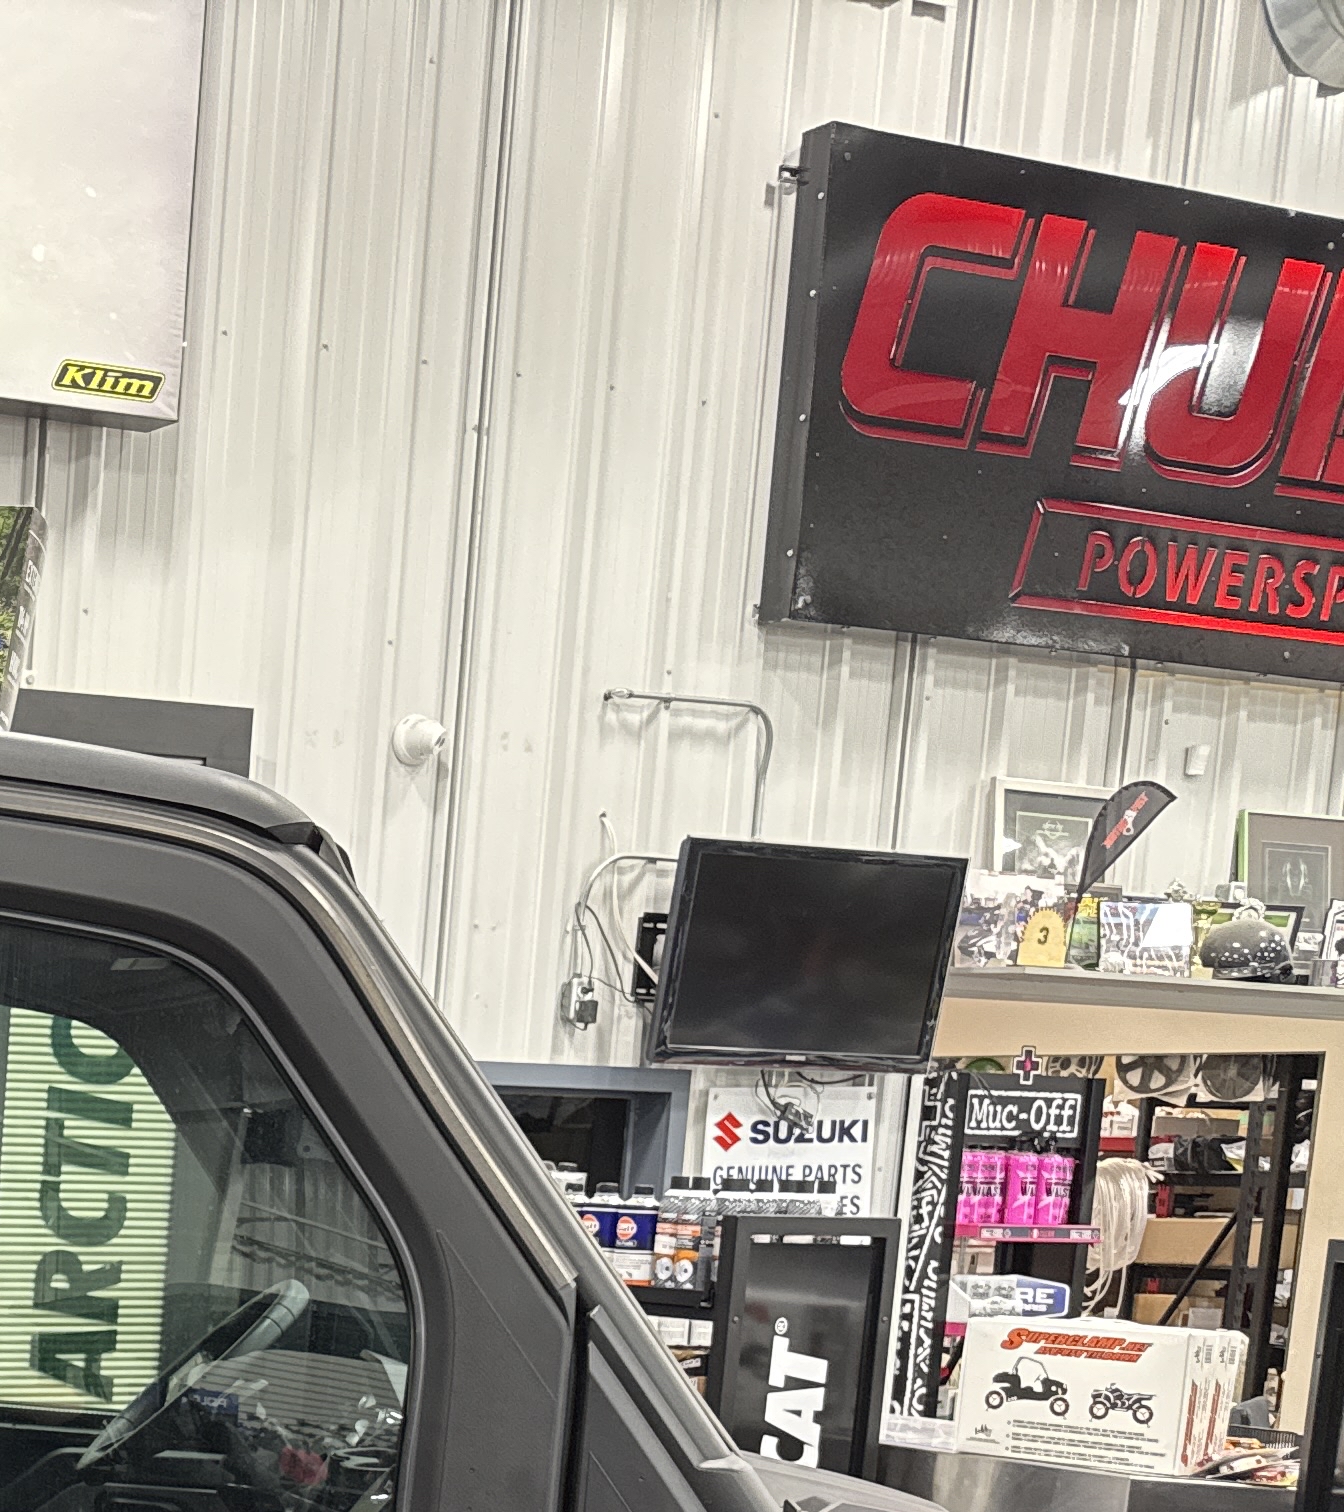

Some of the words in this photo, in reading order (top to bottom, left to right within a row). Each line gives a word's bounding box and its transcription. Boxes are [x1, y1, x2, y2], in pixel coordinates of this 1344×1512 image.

[59, 366, 154, 397] Klim
[1037, 926, 1050, 945] 3
[969, 1098, 1076, 1132] Muc-Off
[802, 1163, 863, 1185] PARTS
